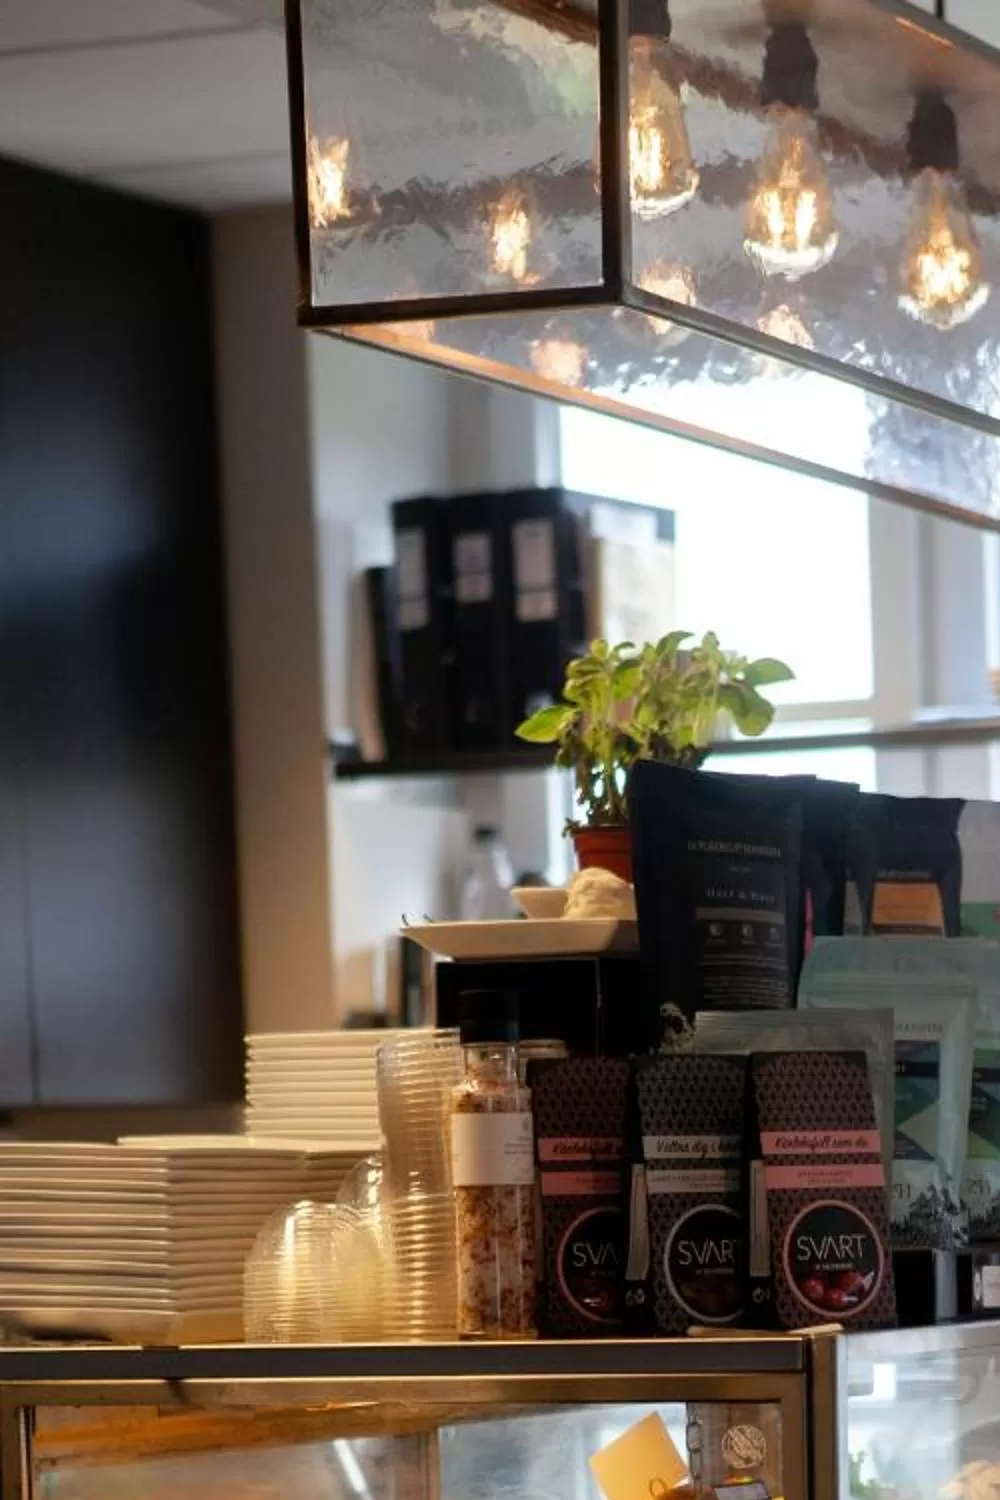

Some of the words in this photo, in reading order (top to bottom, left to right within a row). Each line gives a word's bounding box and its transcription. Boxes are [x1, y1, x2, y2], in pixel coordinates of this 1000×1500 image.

[572, 1242, 619, 1268] SVA
[678, 1238, 737, 1266] SVAR
[796, 1232, 867, 1262] SVART
